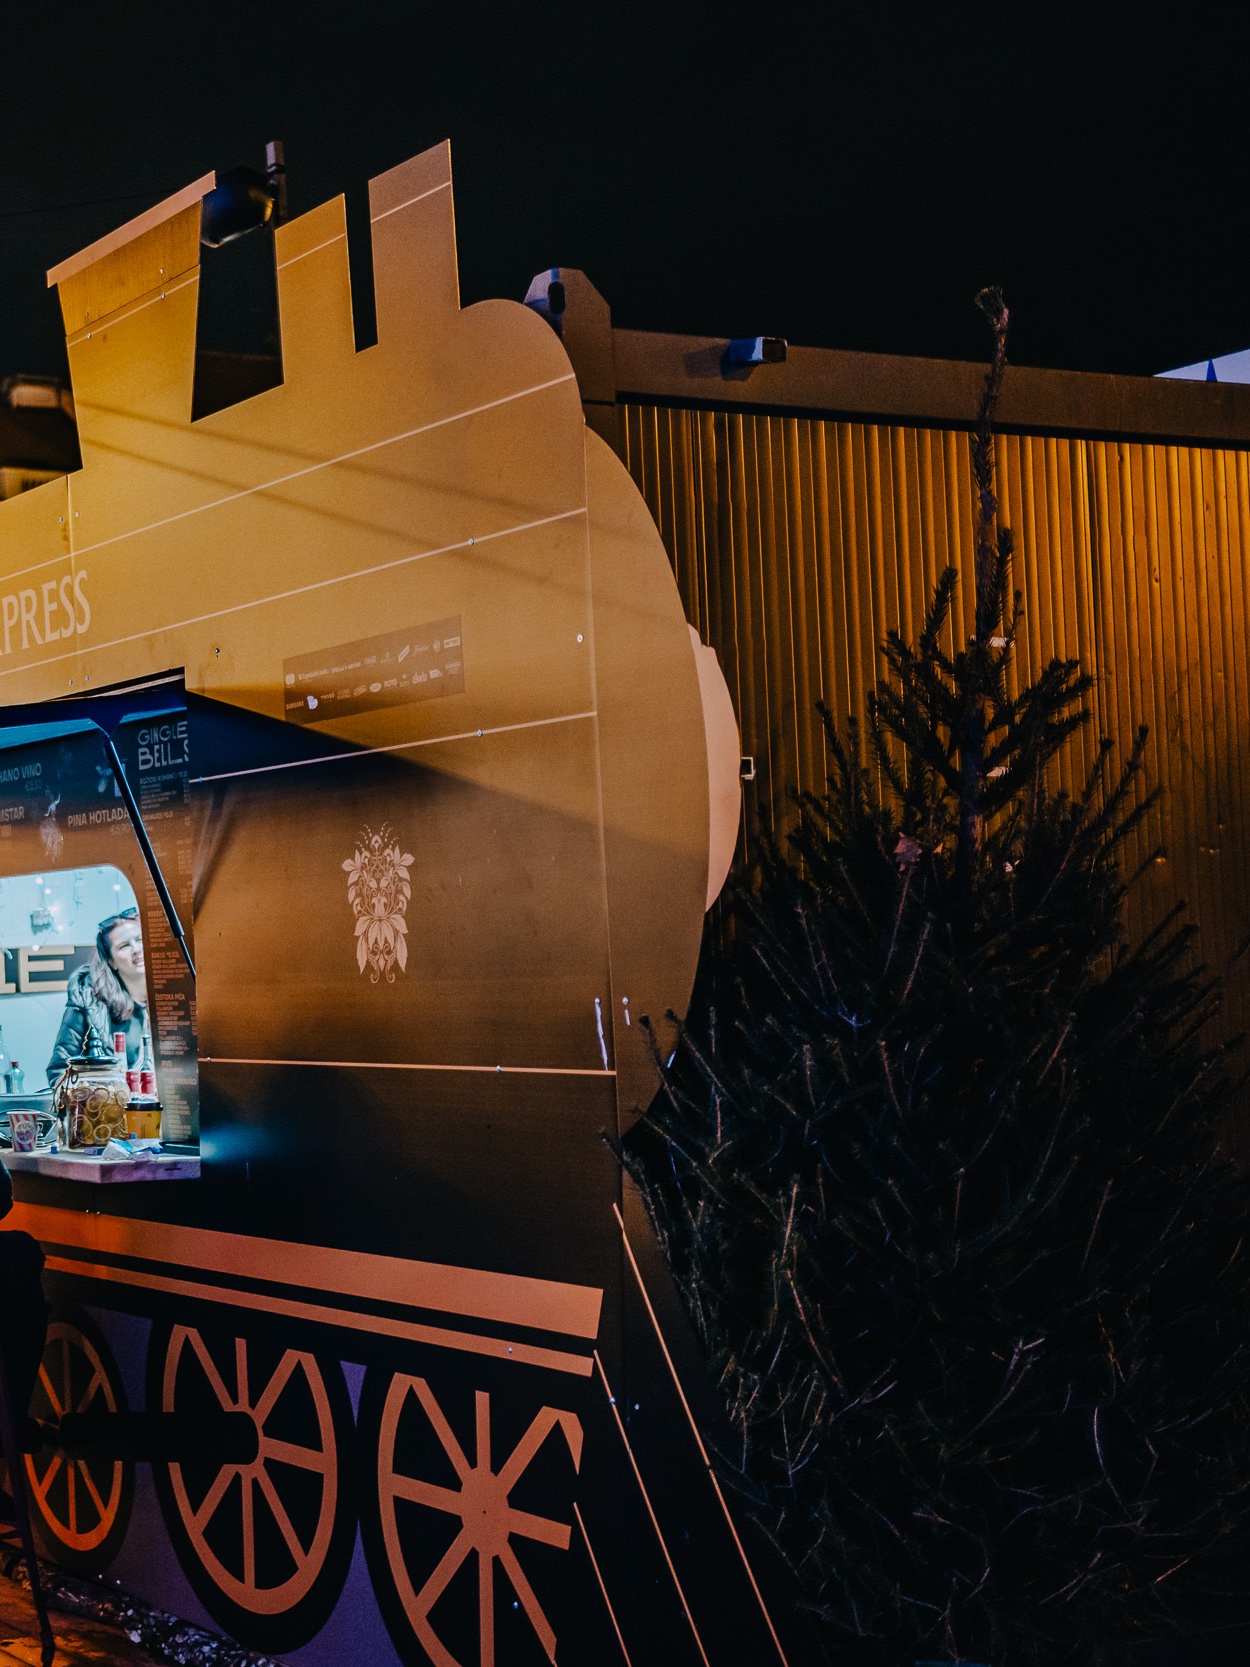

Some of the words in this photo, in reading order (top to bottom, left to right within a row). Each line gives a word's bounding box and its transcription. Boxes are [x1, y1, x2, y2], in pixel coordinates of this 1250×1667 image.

[137, 720, 188, 746] GINGLE
[138, 739, 190, 771] BELLS
[21, 763, 42, 779] VINO
[67, 813, 88, 828] PINA
[88, 806, 130, 826] HOTLADA
